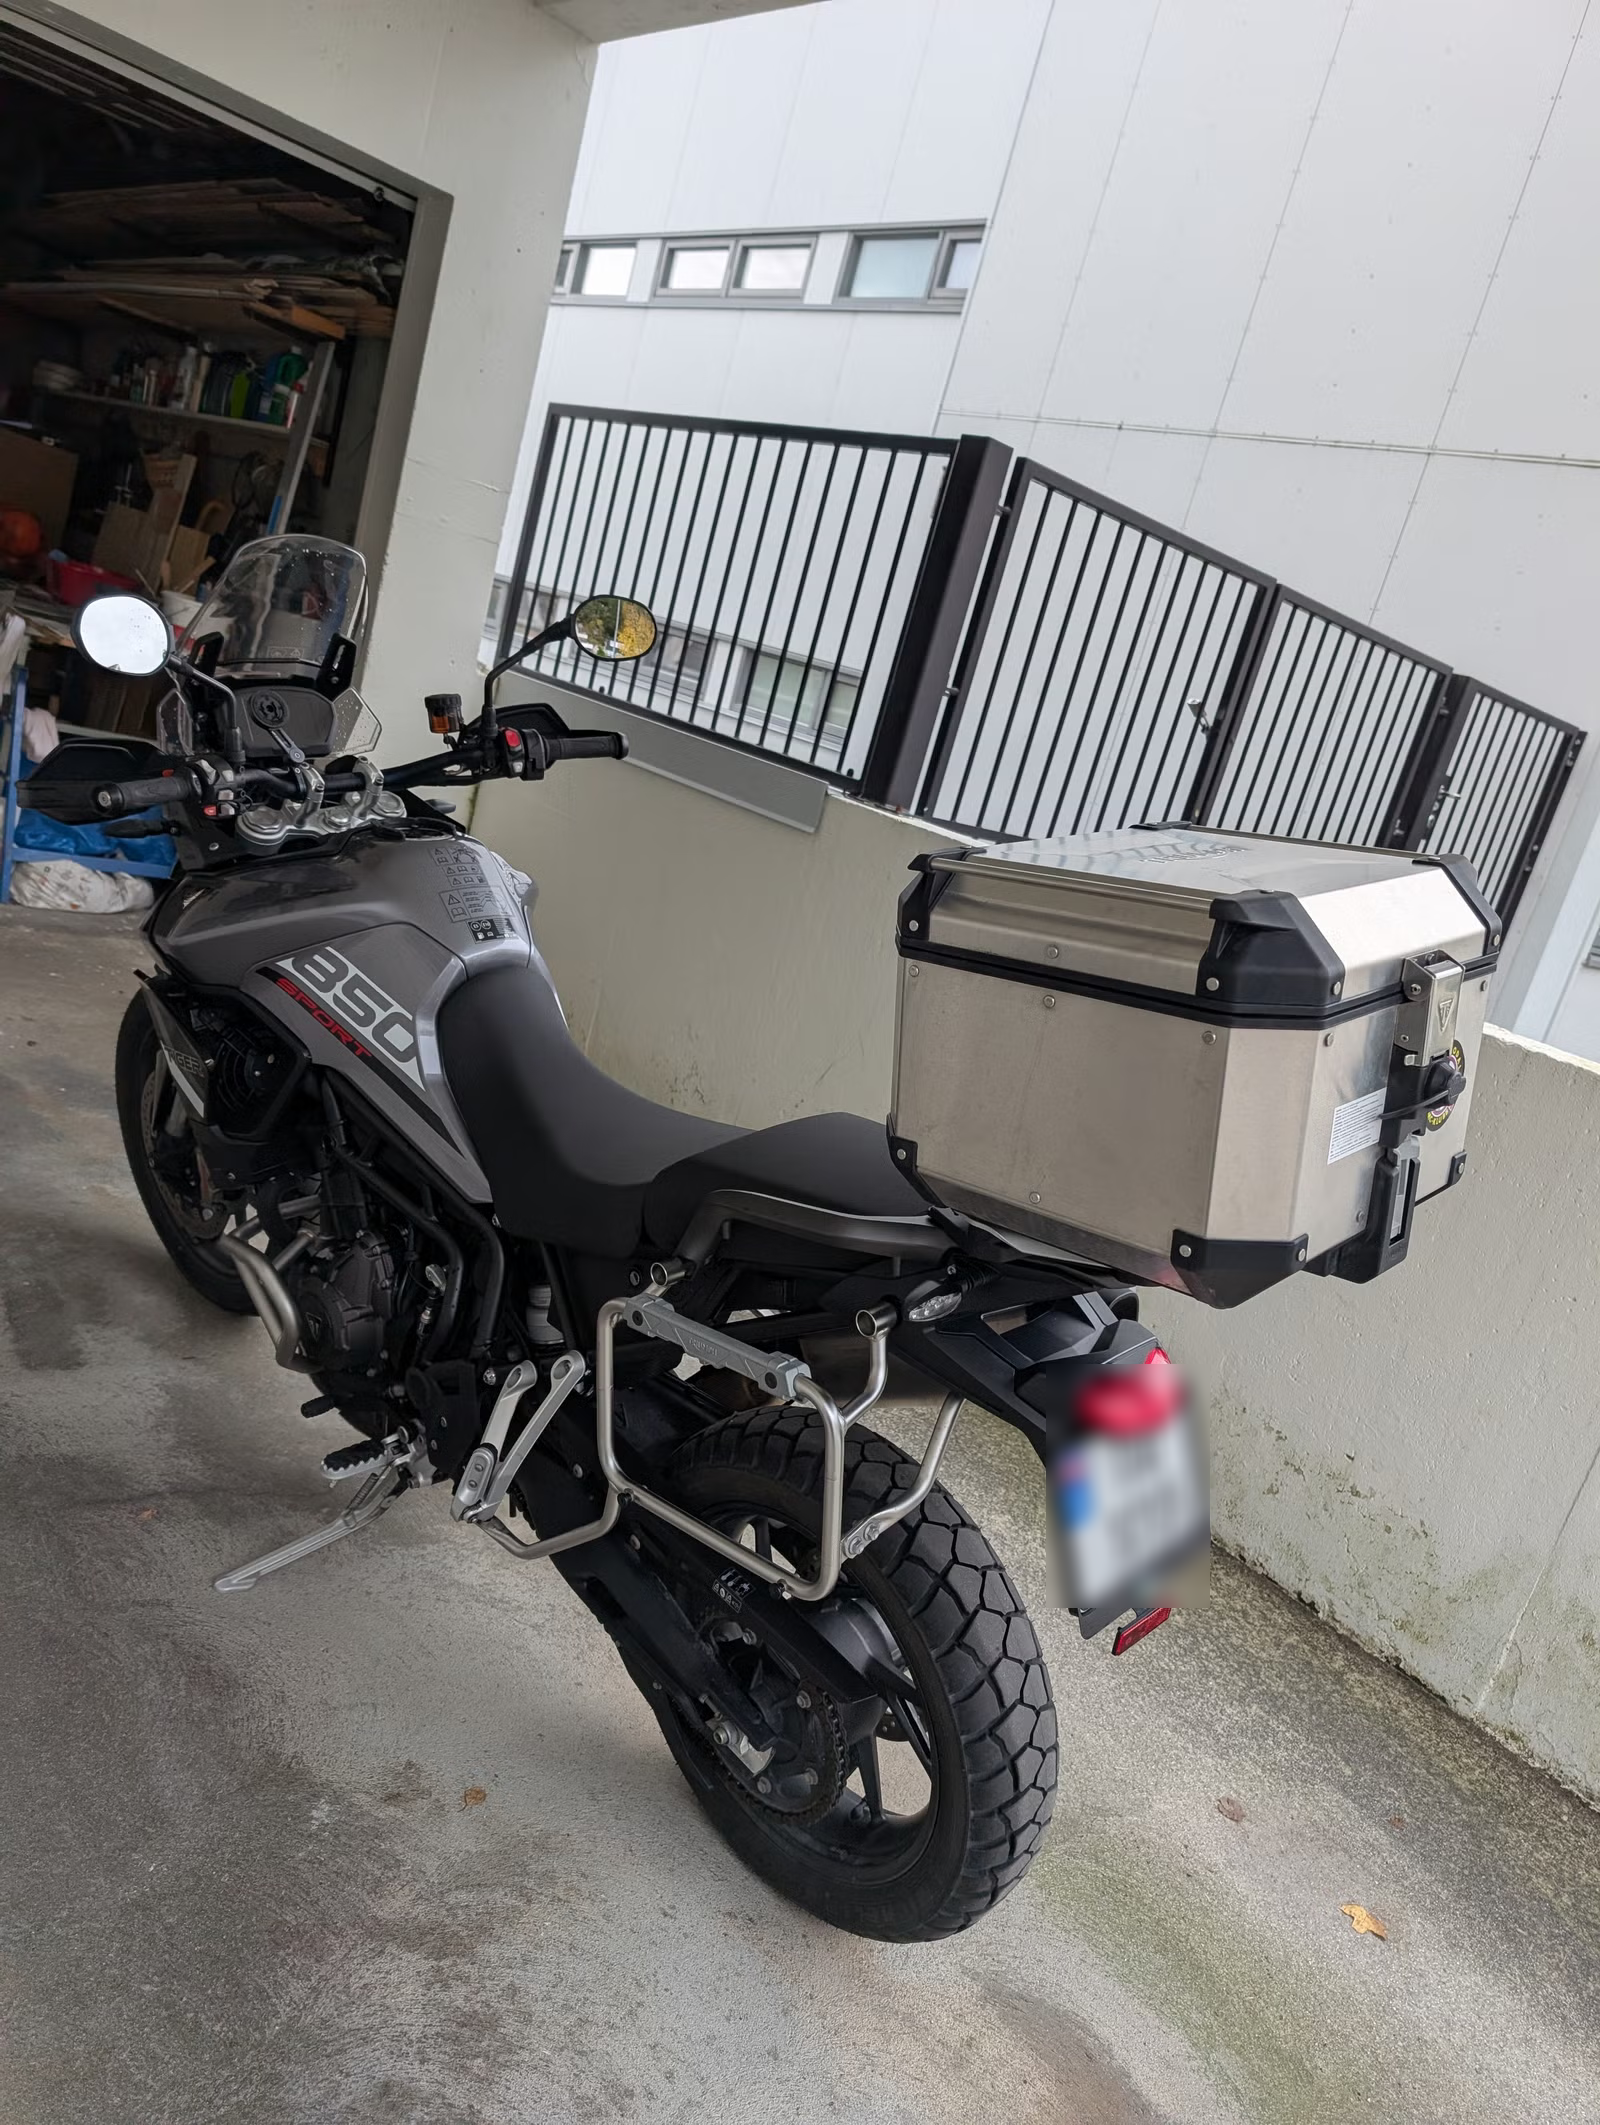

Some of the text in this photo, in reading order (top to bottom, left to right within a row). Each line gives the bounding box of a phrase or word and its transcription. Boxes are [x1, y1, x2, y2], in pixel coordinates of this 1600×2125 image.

[276, 977, 372, 1057] SPORT
[287, 947, 419, 1066] 850
[164, 1045, 202, 1075] TIGER
